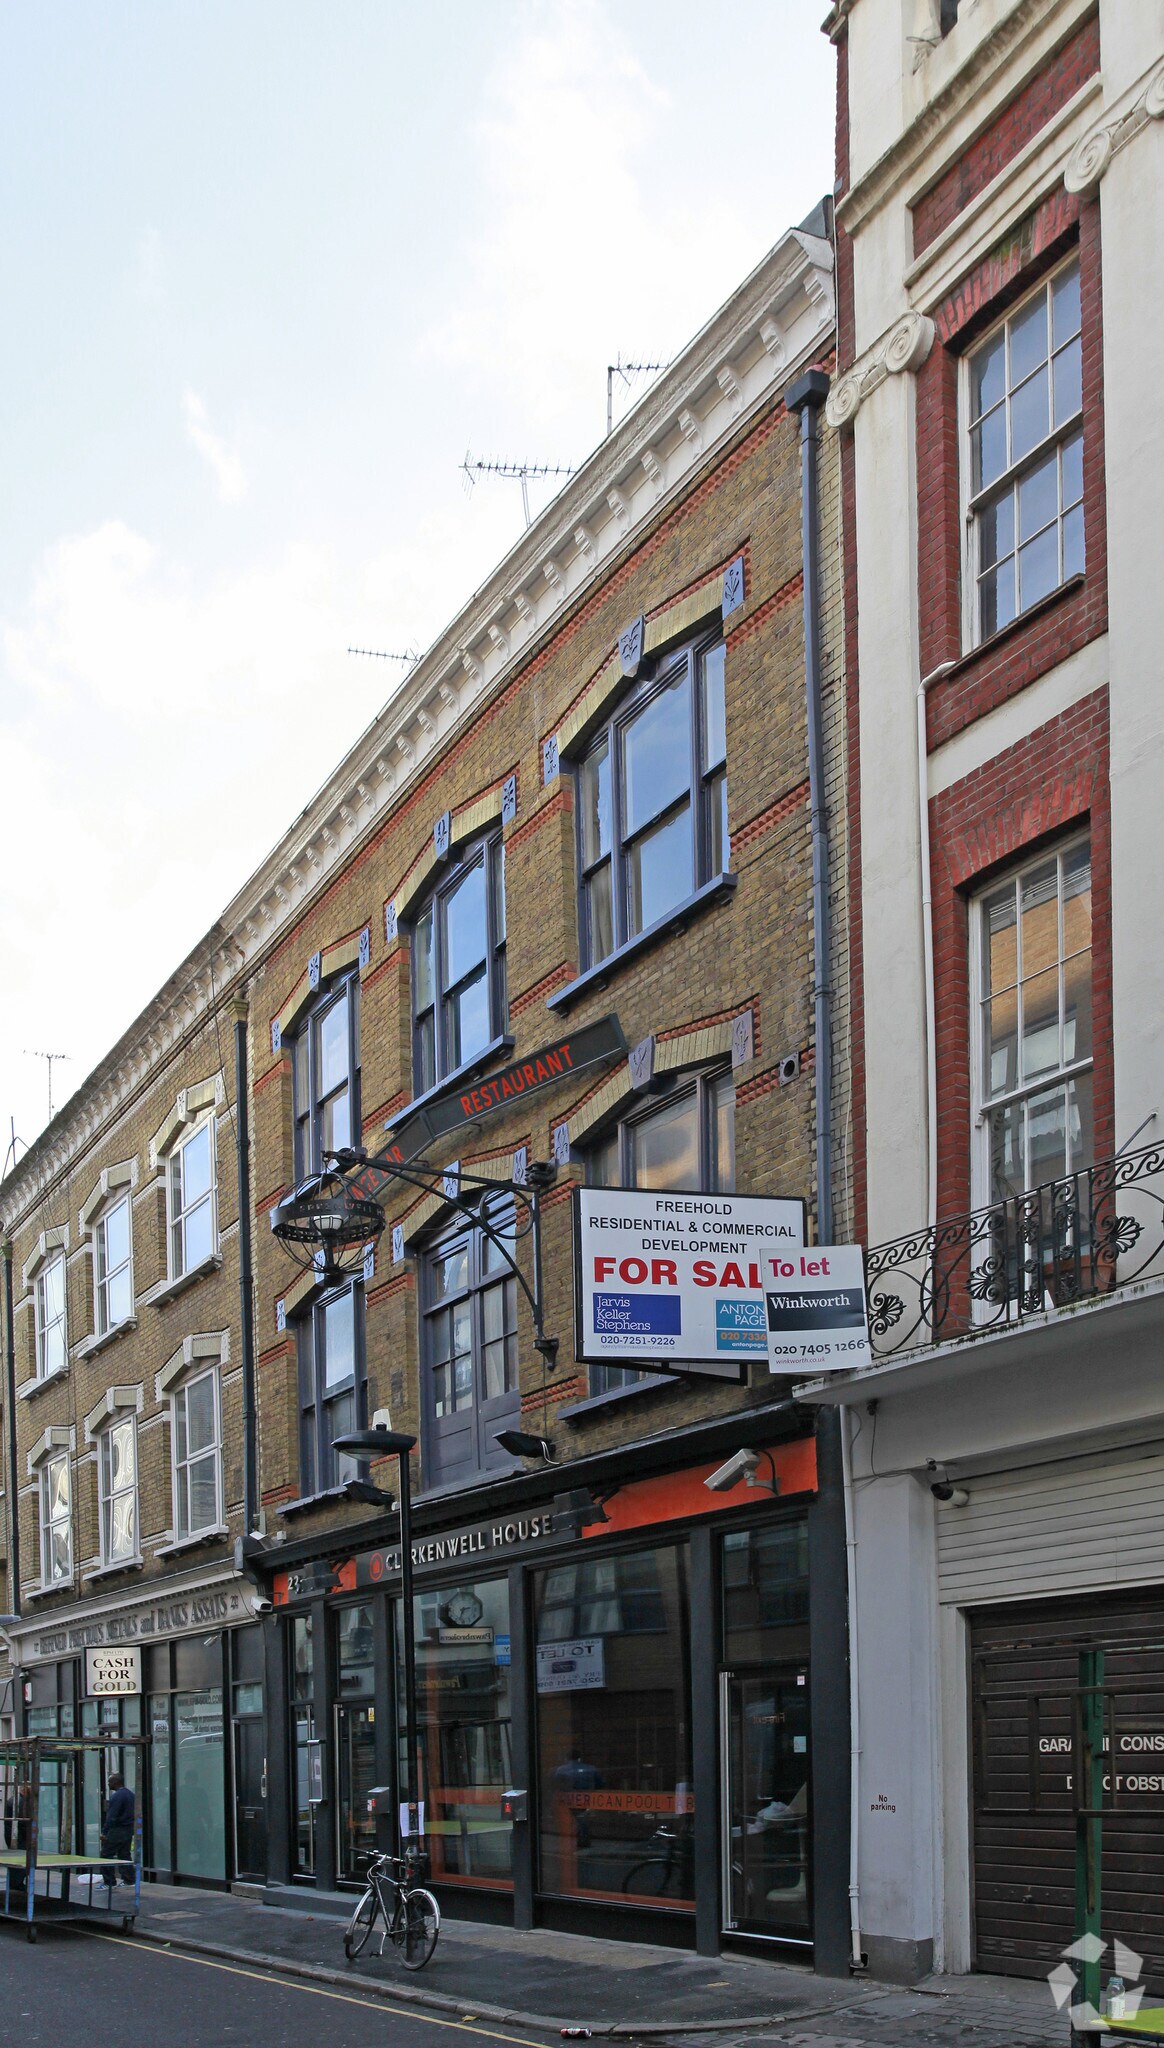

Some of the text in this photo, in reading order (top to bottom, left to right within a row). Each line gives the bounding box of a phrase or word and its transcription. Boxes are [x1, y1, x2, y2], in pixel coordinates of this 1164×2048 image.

[460, 1045, 574, 1116] RESTAURANT
[655, 1200, 732, 1216] FREEHOLD
[589, 1216, 796, 1238] RESIDENTIAL & COMMERCIAL
[641, 1238, 748, 1255] DEVELOPMENT
[594, 1256, 764, 1289] FOR SAL
[768, 1256, 831, 1277] To let
[597, 1295, 630, 1308] Jarvis
[770, 1293, 851, 1309] Winkworth
[596, 1308, 631, 1320] Keller
[734, 1314, 765, 1326] PAGE
[596, 1319, 651, 1332] Stephens
[600, 1335, 675, 1346] 020-7251-9226
[720, 1332, 740, 1341] 020
[731, 1341, 767, 1349] antonpage.
[774, 1339, 865, 1355] 020 7405 1266
[776, 1356, 826, 1365] winkworth.co.uk
[385, 1514, 551, 1571] CLRKENWELL HOUSE
[93, 1657, 135, 1669] CASH
[99, 1669, 130, 1680] FOR
[93, 1681, 137, 1692] GOLD
[627, 1795, 661, 1810] POOL
[879, 1794, 888, 1803] No
[871, 1803, 896, 1813] parking
